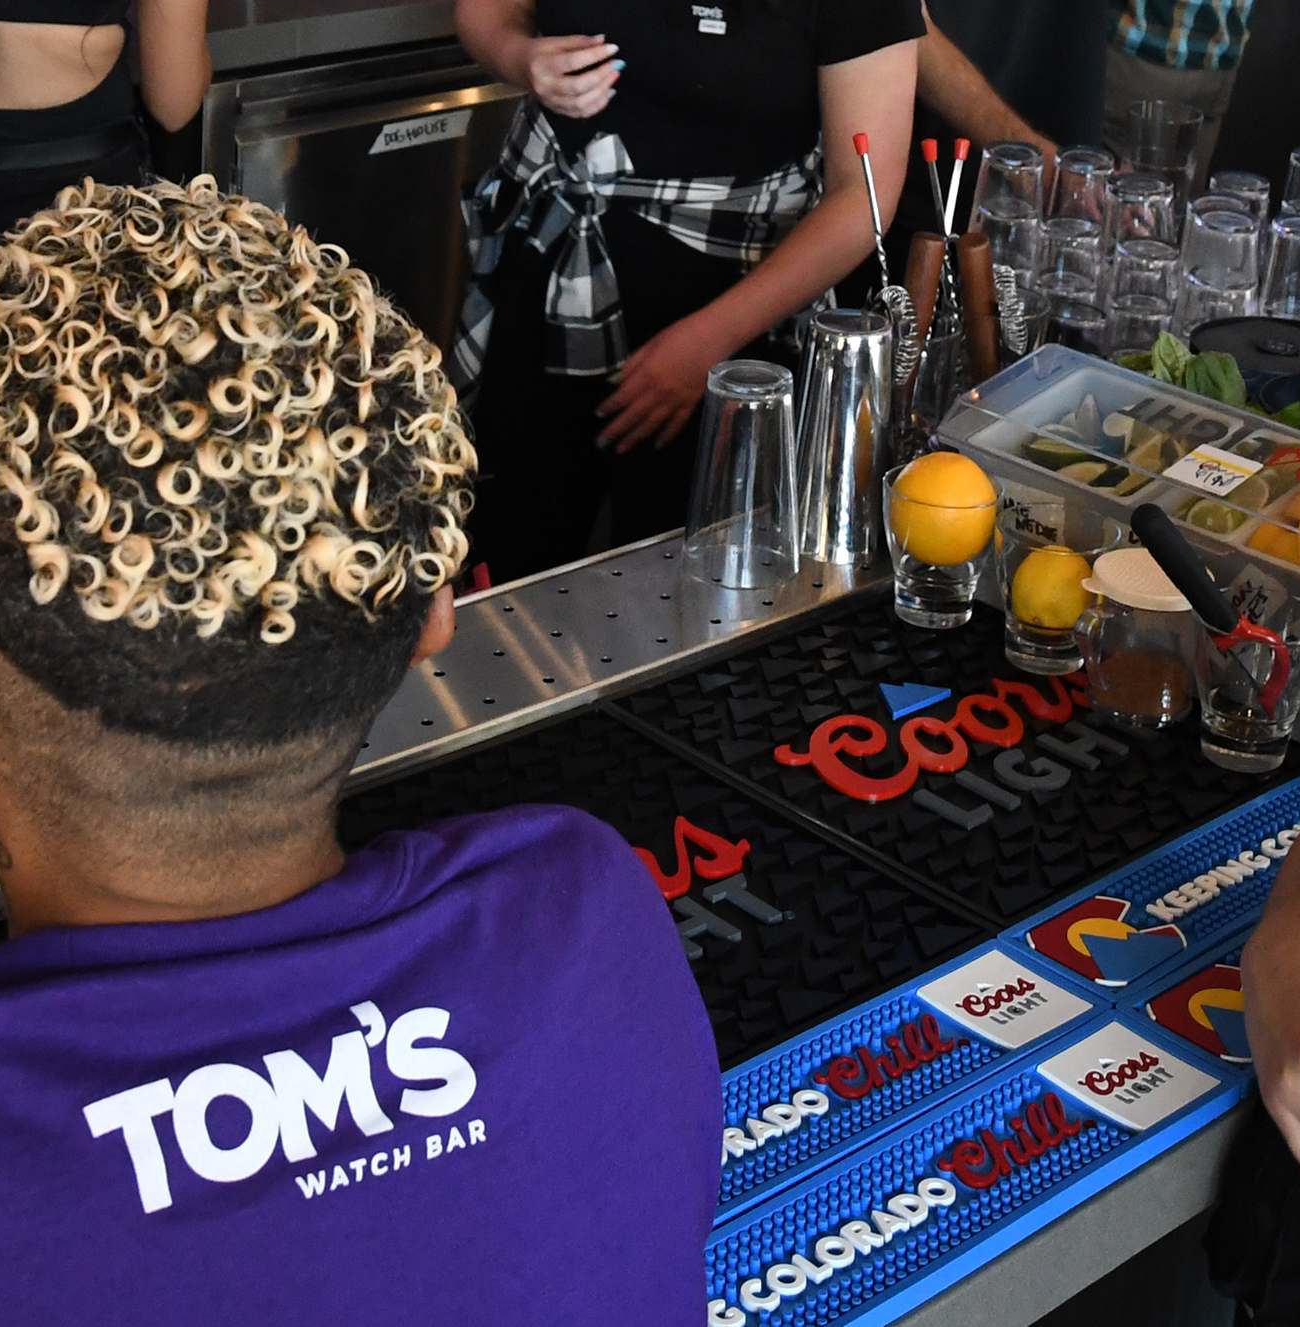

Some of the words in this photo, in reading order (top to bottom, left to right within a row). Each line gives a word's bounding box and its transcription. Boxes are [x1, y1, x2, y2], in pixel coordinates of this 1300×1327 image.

[1145, 849, 1271, 923] KEEPING
[955, 974, 1037, 1018] Coors
[989, 991, 1049, 1025] LIGHT
[1077, 1051, 1161, 1096] Coors
[1114, 1067, 1175, 1105] LIGHT
[82, 999, 478, 1215] TOM'S
[295, 1144, 413, 1200] WATCH
[425, 1118, 488, 1161] BAR
[740, 1177, 957, 1314] COLORADO
